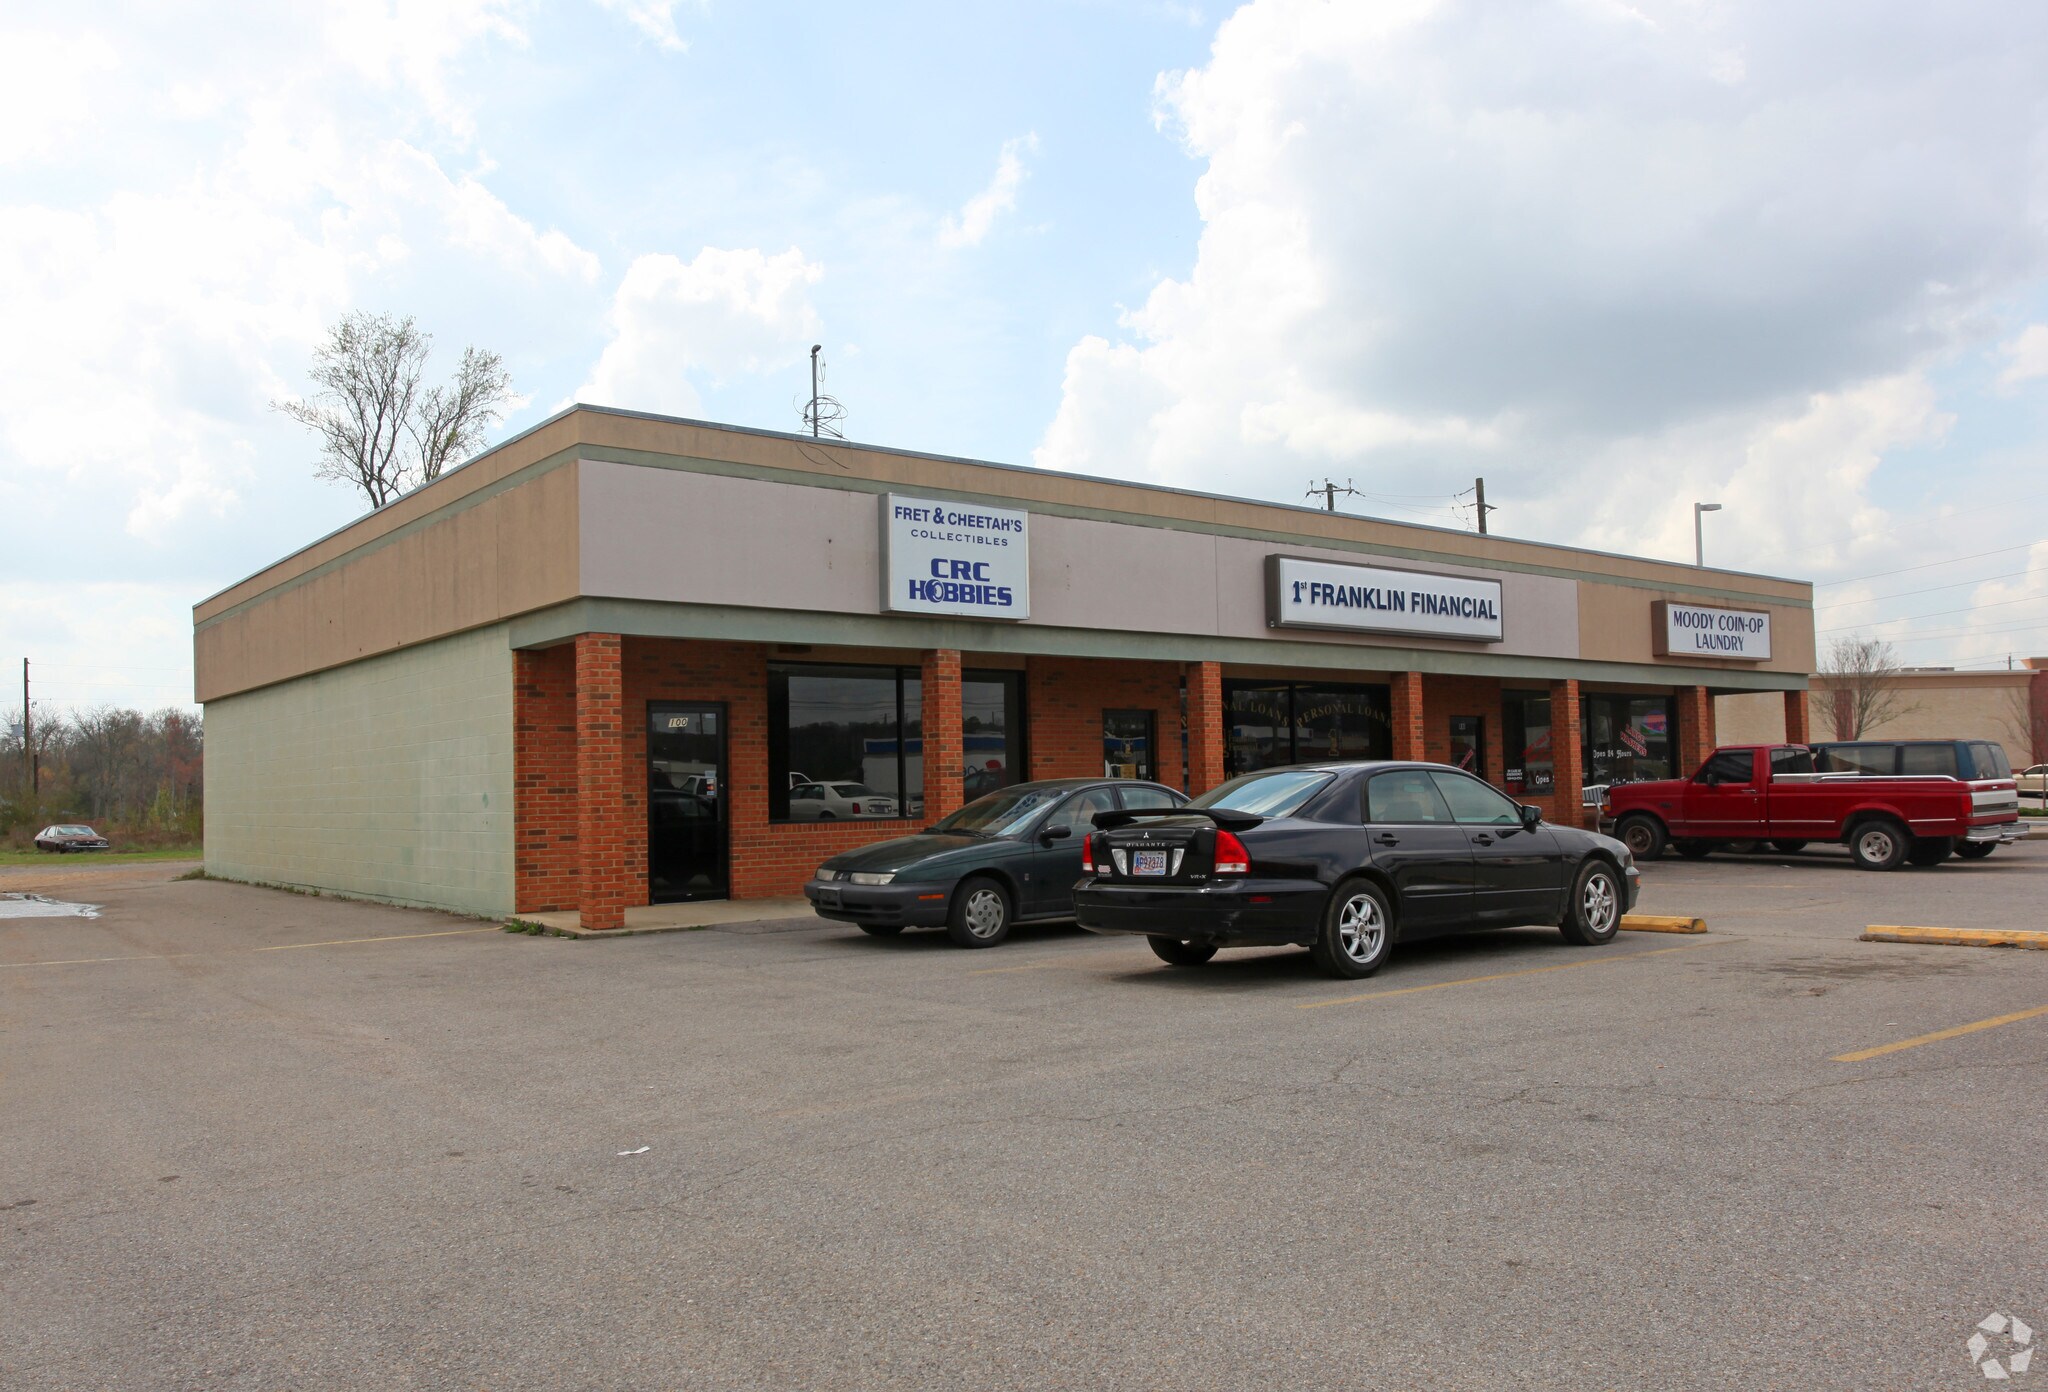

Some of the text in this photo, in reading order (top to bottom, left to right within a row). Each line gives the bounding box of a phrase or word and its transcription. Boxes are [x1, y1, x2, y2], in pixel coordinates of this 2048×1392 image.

[895, 506, 1023, 532] FRET & CHEETAH'S
[911, 529, 1008, 546] COLLECTIBLES
[931, 558, 990, 582] CRC
[909, 578, 1013, 607] HOBBIES
[1293, 581, 1498, 620] 1st FRANKLIN FINANCIAL
[1673, 611, 1764, 633] MOODY COIN-OP
[1696, 633, 1744, 651] LAUNDRY
[669, 718, 688, 727] 100
[1593, 749, 1606, 758] Open
[1620, 731, 1648, 757] WASHERS
